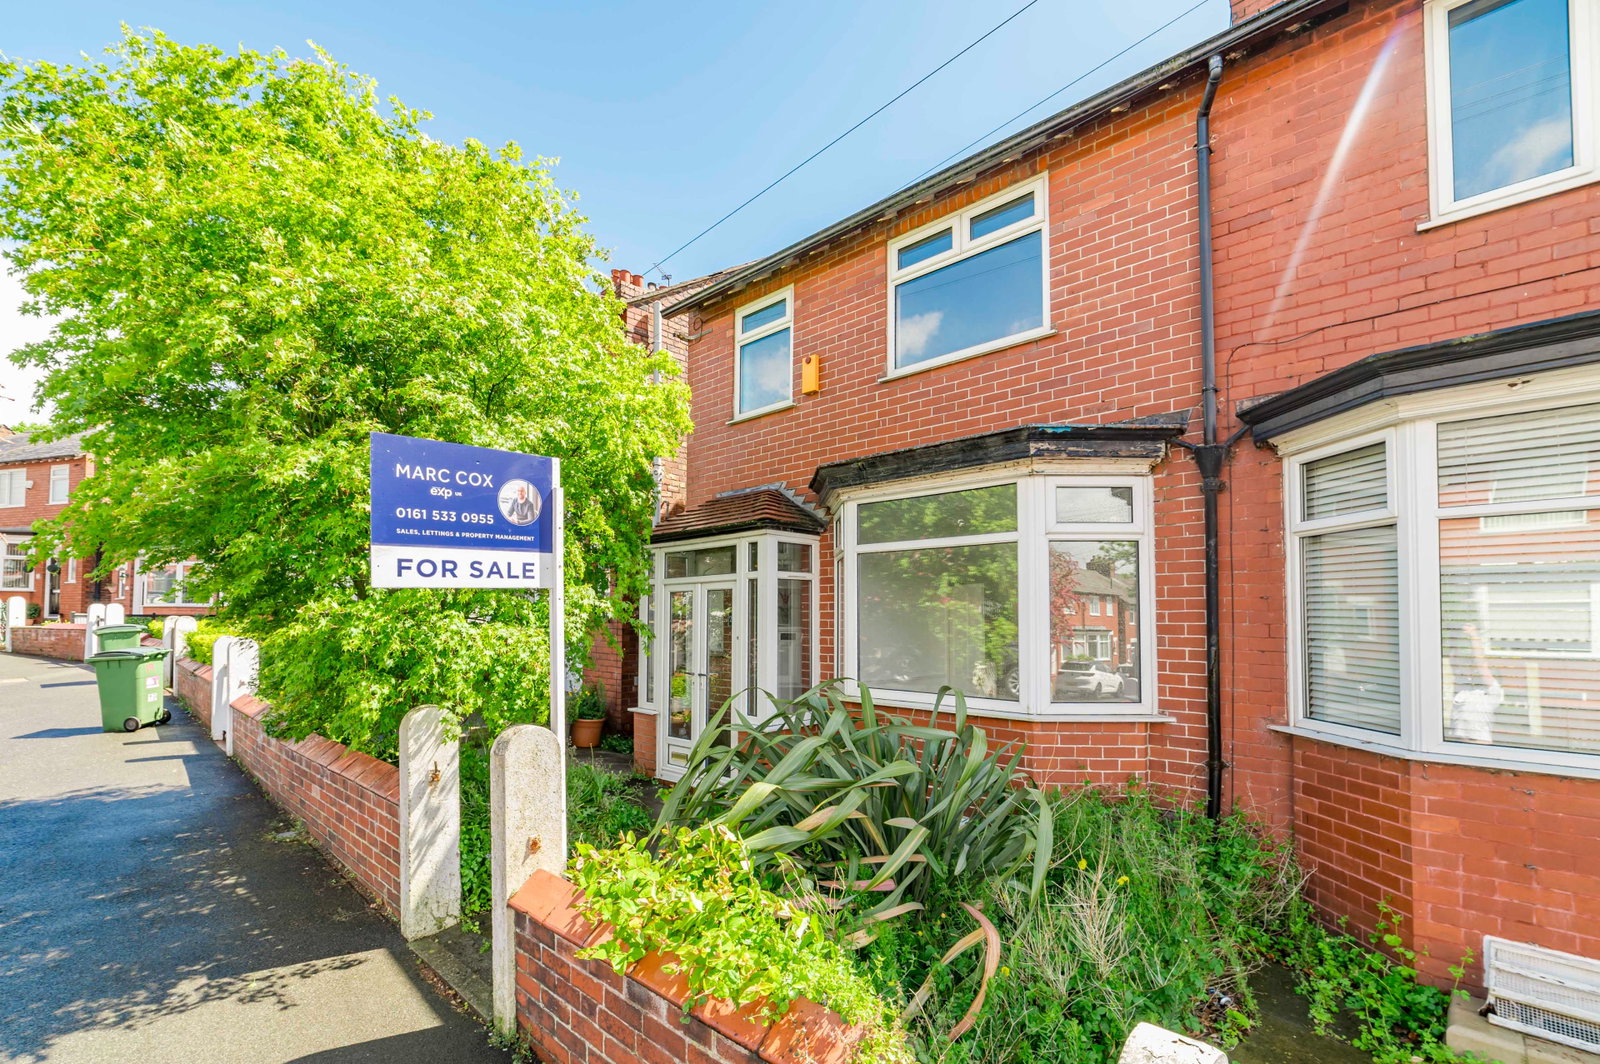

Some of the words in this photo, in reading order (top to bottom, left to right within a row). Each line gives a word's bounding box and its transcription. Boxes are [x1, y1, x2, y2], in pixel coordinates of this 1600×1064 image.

[395, 463, 450, 483] MARC
[455, 471, 494, 488] COX
[396, 507, 427, 520] 0161
[432, 510, 457, 522] 533
[461, 513, 494, 525] 0955
[397, 558, 458, 578] FOR
[469, 560, 535, 579] SALE
